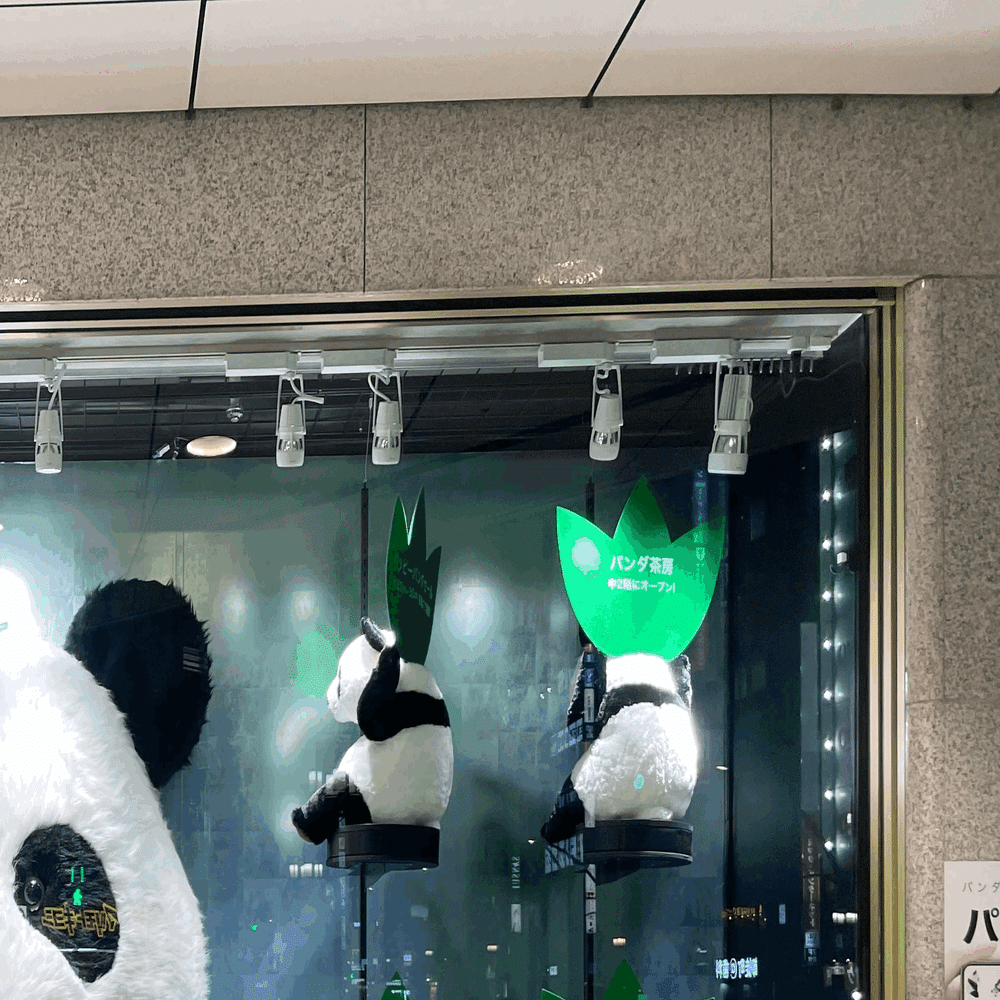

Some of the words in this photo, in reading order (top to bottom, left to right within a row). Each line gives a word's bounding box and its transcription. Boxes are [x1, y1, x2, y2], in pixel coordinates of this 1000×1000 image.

[610, 555, 675, 576] パンダ茶房
[963, 907, 999, 944] パ
